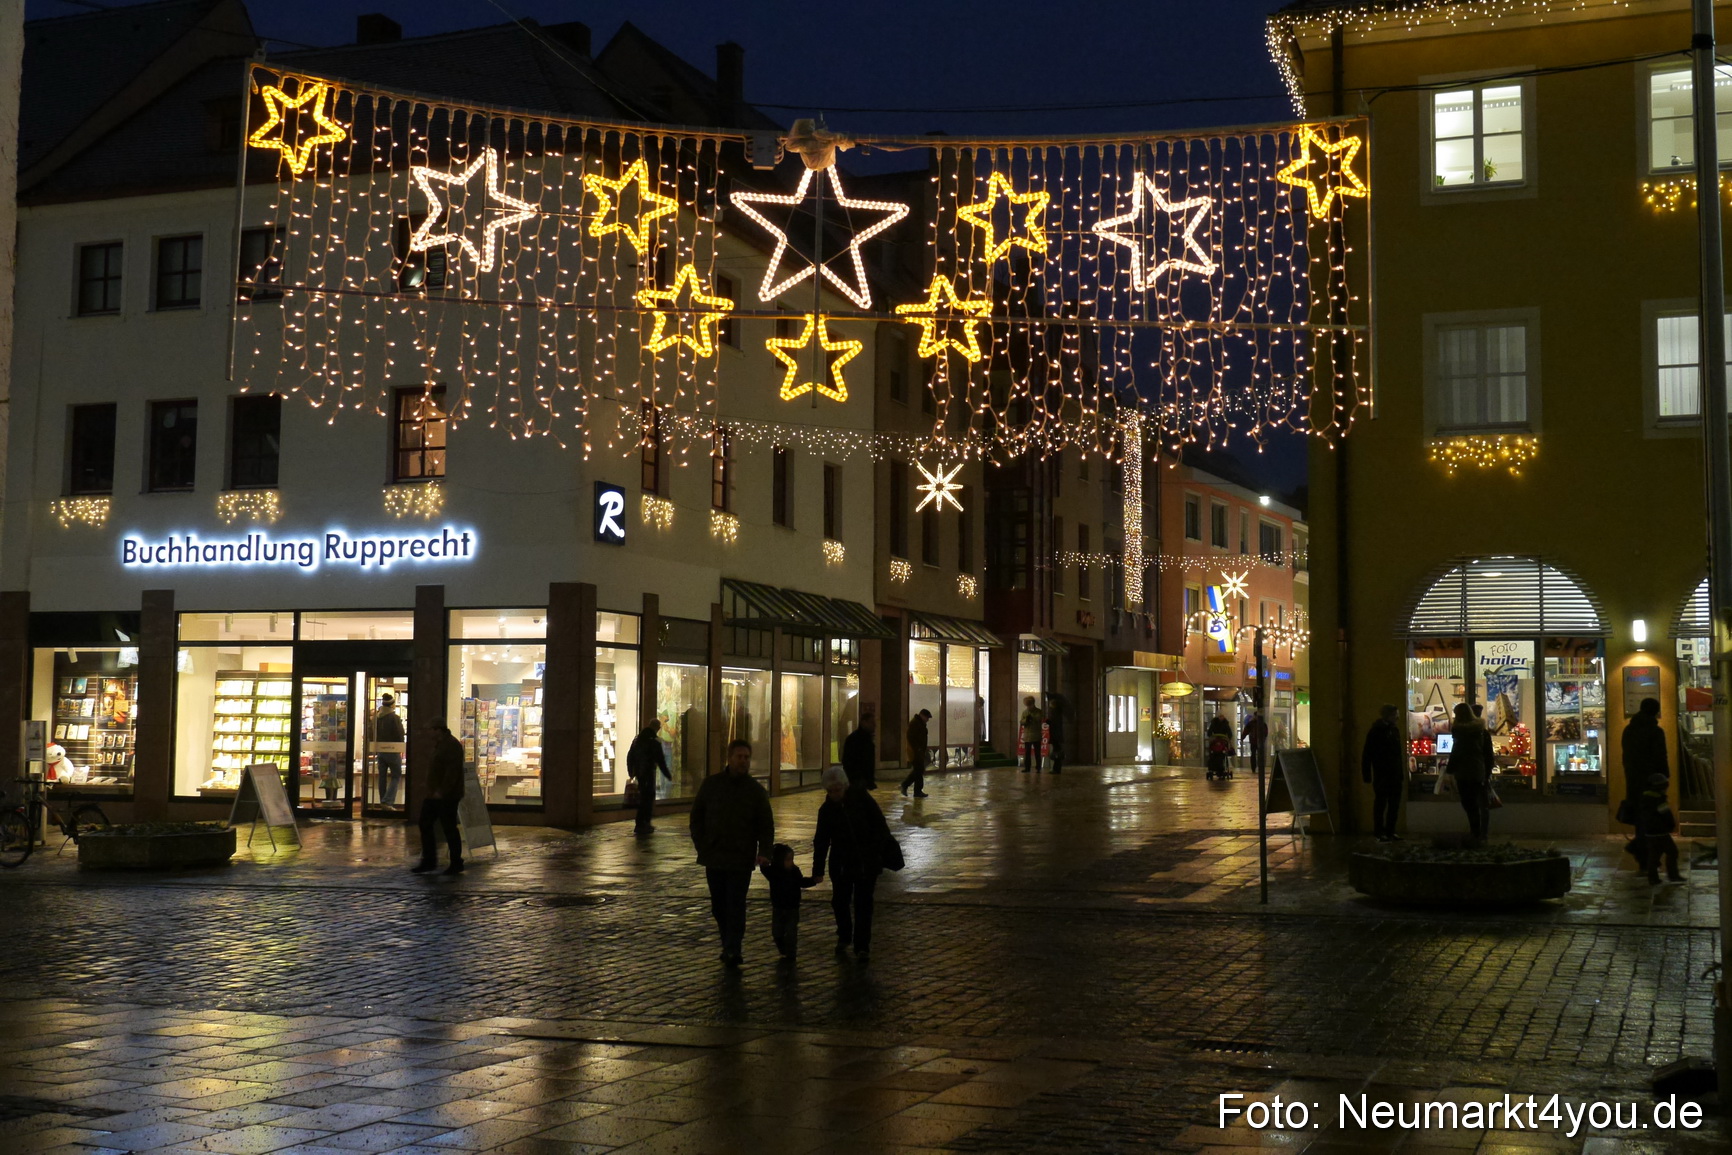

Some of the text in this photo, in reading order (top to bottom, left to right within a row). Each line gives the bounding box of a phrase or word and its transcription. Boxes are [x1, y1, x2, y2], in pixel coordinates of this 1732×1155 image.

[599, 491, 625, 538] R
[122, 528, 471, 567] Buchhandlung Rupprecht
[1480, 655, 1527, 665] hailer
[1489, 642, 1517, 656] FOTO
